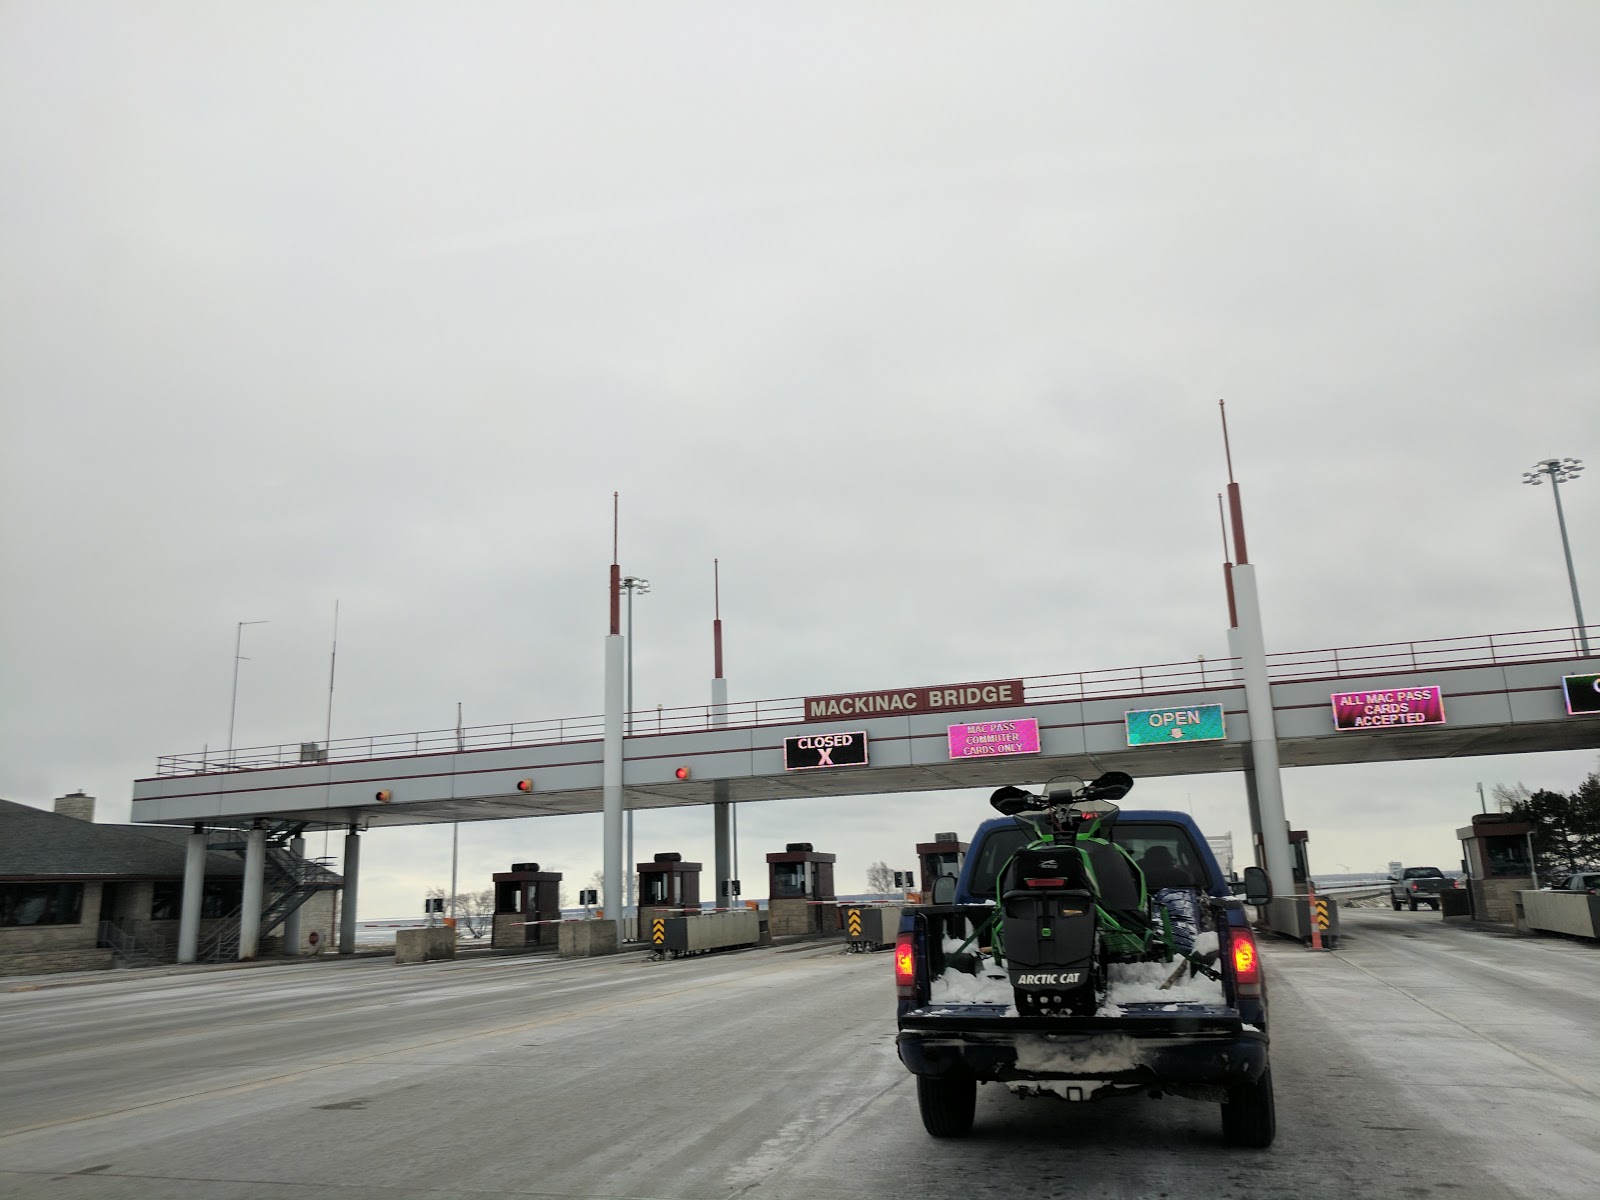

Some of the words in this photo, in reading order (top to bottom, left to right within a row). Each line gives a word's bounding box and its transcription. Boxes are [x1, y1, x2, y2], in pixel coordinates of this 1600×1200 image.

[810, 692, 918, 717] MACKINAC
[928, 685, 1013, 707] BRIDGE
[1340, 696, 1364, 706] ALL
[1366, 693, 1394, 704] MAC
[1396, 690, 1432, 701] PASS
[1364, 702, 1409, 714] CARDS
[1148, 710, 1201, 727] OPEN
[1355, 712, 1426, 727] ACCEPTED
[967, 724, 988, 734] MAC
[990, 722, 1017, 732] PASS
[797, 734, 853, 749] CLOSED
[966, 732, 1020, 745] COMMUTER
[963, 745, 995, 755] CARDS
[997, 743, 1023, 753] ONLY
[1017, 973, 1058, 985] ARCTIC
[1059, 972, 1081, 984] CAT
